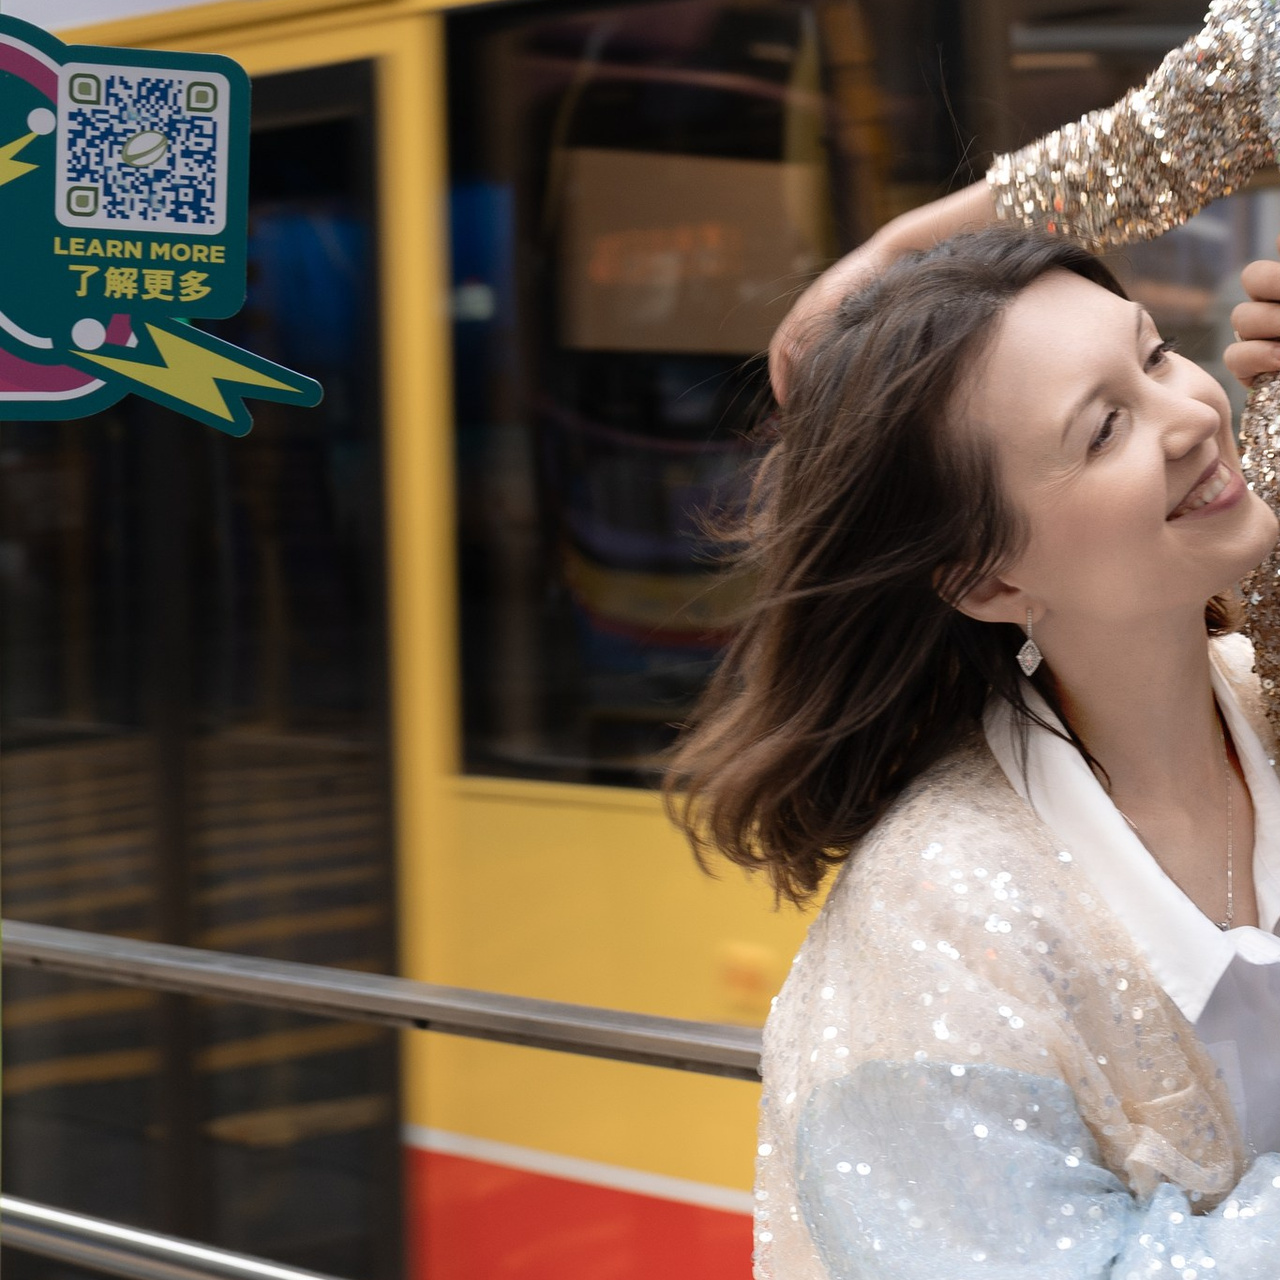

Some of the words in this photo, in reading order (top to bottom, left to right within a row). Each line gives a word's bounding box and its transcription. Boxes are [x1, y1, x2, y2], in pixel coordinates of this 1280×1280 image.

[53, 236, 143, 260] LEARN
[150, 241, 226, 264] MORE
[68, 264, 212, 302] 了解更多
